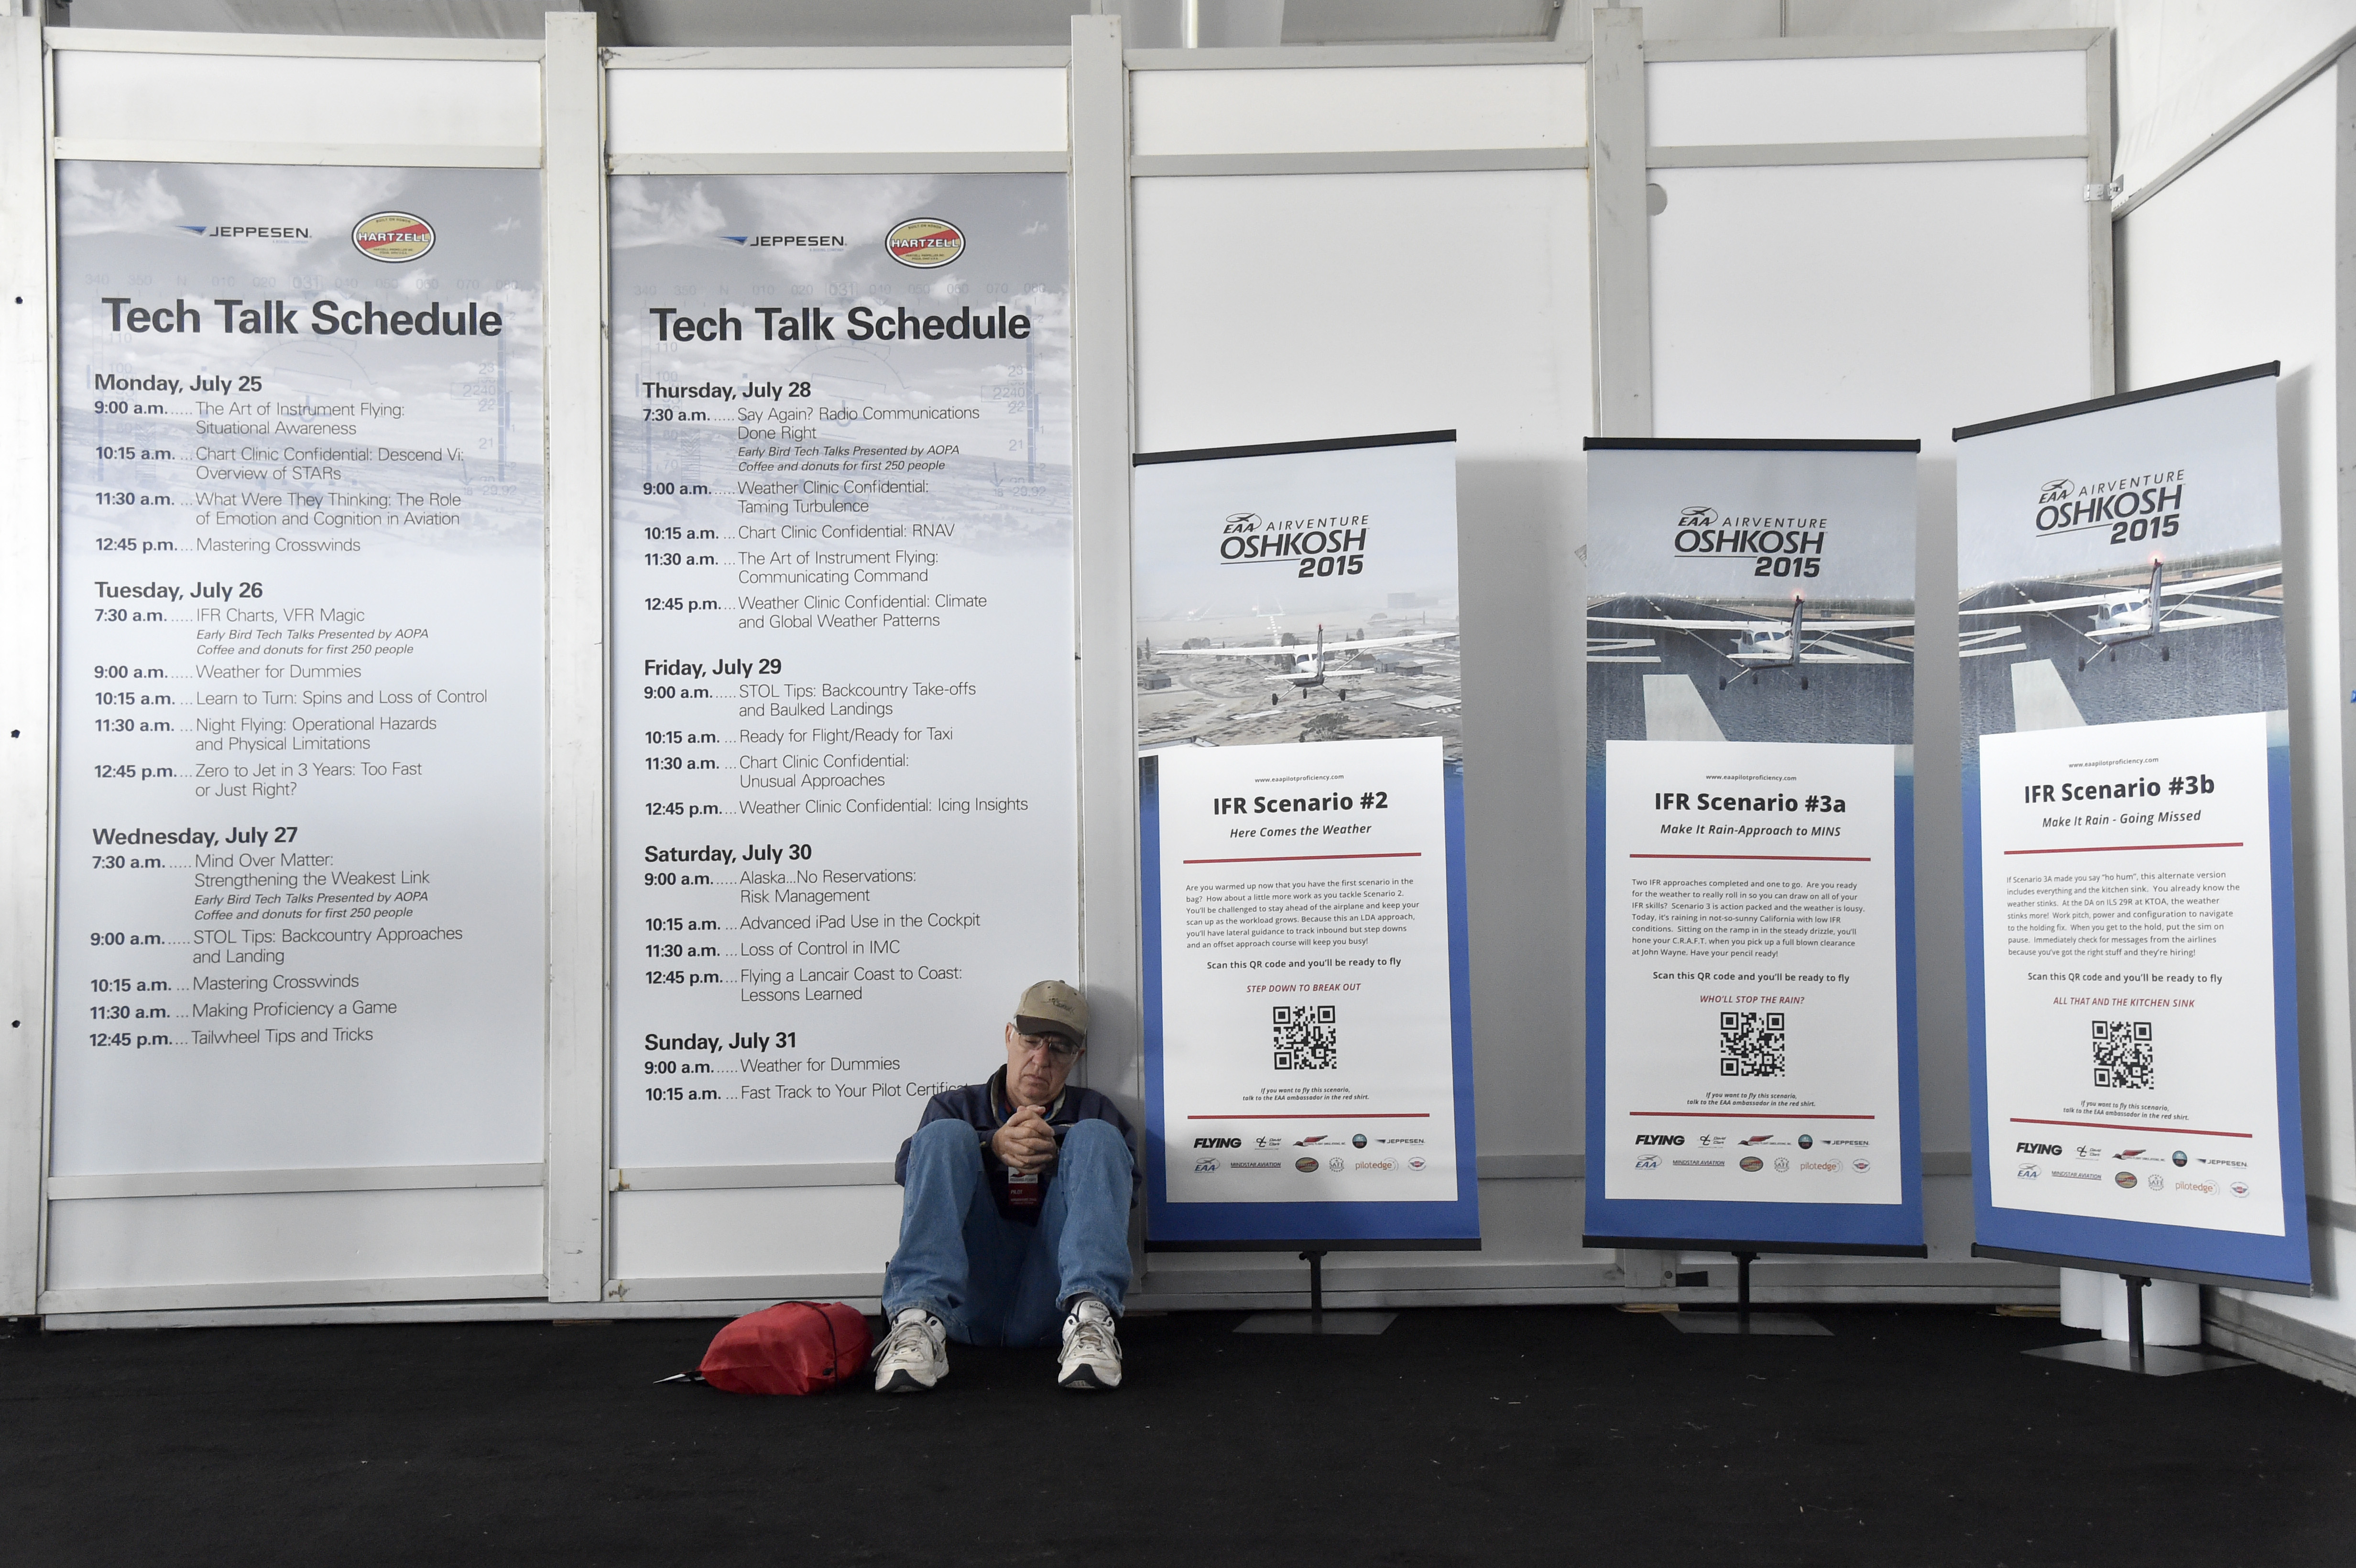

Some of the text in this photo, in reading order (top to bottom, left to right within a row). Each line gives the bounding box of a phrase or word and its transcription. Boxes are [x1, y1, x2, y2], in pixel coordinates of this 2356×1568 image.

[210, 227, 308, 238] JEPPESEN
[359, 232, 430, 242] HARTZELL
[750, 236, 843, 246] JEPPESEN
[891, 239, 960, 248] HARTZELL
[829, 283, 854, 296] 031
[102, 298, 502, 336] Tech Talk Schedule
[650, 306, 1030, 341] Tech Talk Schedule
[96, 374, 262, 395] Monday, July 25
[643, 382, 811, 401] Thursday, July 28
[196, 402, 404, 419] The Art of Instrument Flying:
[196, 421, 356, 435] Situational Awareness
[739, 460, 945, 473] Coffee and donuts for first 250 people
[2039, 469, 2184, 504] EAA AIRVENTURE
[2036, 484, 2182, 530] OSHKOSH
[1223, 515, 1369, 534] EAA AIRVENTURE
[1678, 517, 1827, 528] EAA AIRVENTURE
[2110, 514, 2180, 544] 2015
[1221, 528, 1366, 559] OSHKOSH
[1675, 530, 1824, 554] OSHKOSH
[1298, 555, 1363, 578] 2015
[1754, 557, 1821, 577] 2015
[95, 582, 262, 601] Tuesday, July 26
[197, 608, 364, 624] IFR Charts, VFR Magic
[197, 629, 428, 642] Early Bird Tech Talks Presented by AOPA
[645, 659, 781, 679] Friday, July 29
[2069, 758, 2159, 767] www.eaapilotproficiency.com
[2025, 774, 2214, 803] IFR Scenario #3b
[1214, 792, 1387, 815] IFR Scenario #2
[1656, 793, 1845, 812] IFR Scenario #3a
[2043, 817, 2071, 827] Make
[2074, 817, 2082, 826] It
[2085, 815, 2109, 825] Rain
[2120, 813, 2154, 825] Going
[2158, 811, 2201, 822] Missed
[93, 827, 297, 848] Wednesday, July 27
[1231, 824, 1372, 838] Here Comes the Weather
[1661, 825, 1841, 837] Make It Rain-Approach to MINS
[645, 844, 811, 865] Saturday, July 30
[646, 918, 683, 931] 10:15
[740, 913, 980, 929] Advanced iPad Use in the Cockpit
[191, 1027, 373, 1044] Tailwheel Tips and Tricks
[645, 1032, 795, 1053] Sunday, July 31
[1194, 1138, 1242, 1148] FLYING
[1635, 1135, 1685, 1145] FLYING
[2016, 1143, 2062, 1155] FLYING
[1355, 1161, 1392, 1170] pilotedge
[1800, 1162, 1837, 1172] pilotedge
[2175, 1182, 2213, 1193] pilotedge
